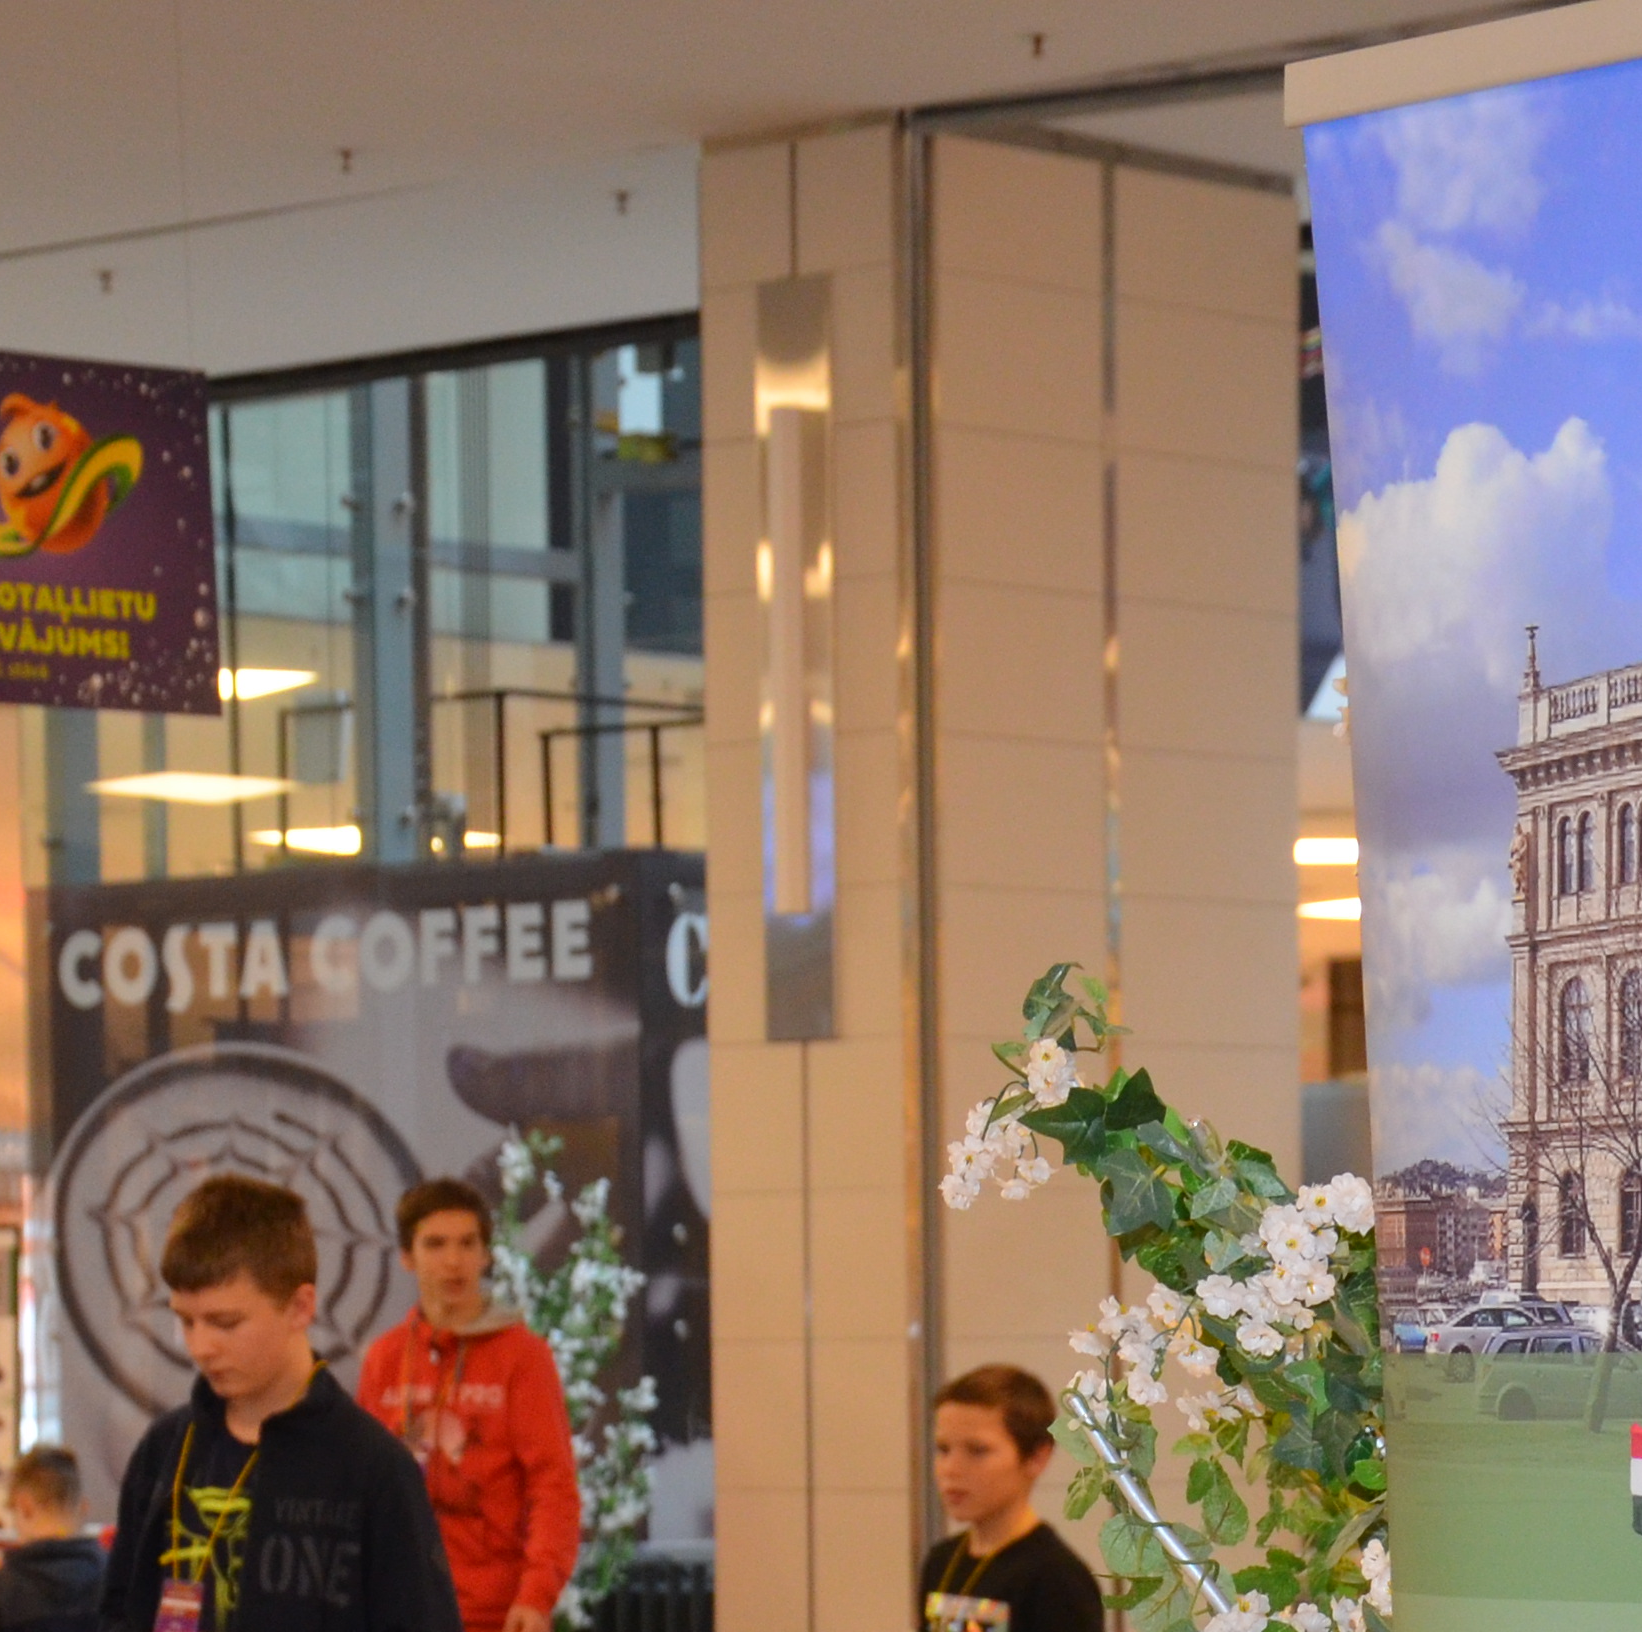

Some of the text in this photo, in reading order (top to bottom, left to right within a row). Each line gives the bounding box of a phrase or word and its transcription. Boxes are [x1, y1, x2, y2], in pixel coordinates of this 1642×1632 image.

[58, 898, 594, 1013] COSTA COFFEE
[260, 1534, 361, 1608] ONE
